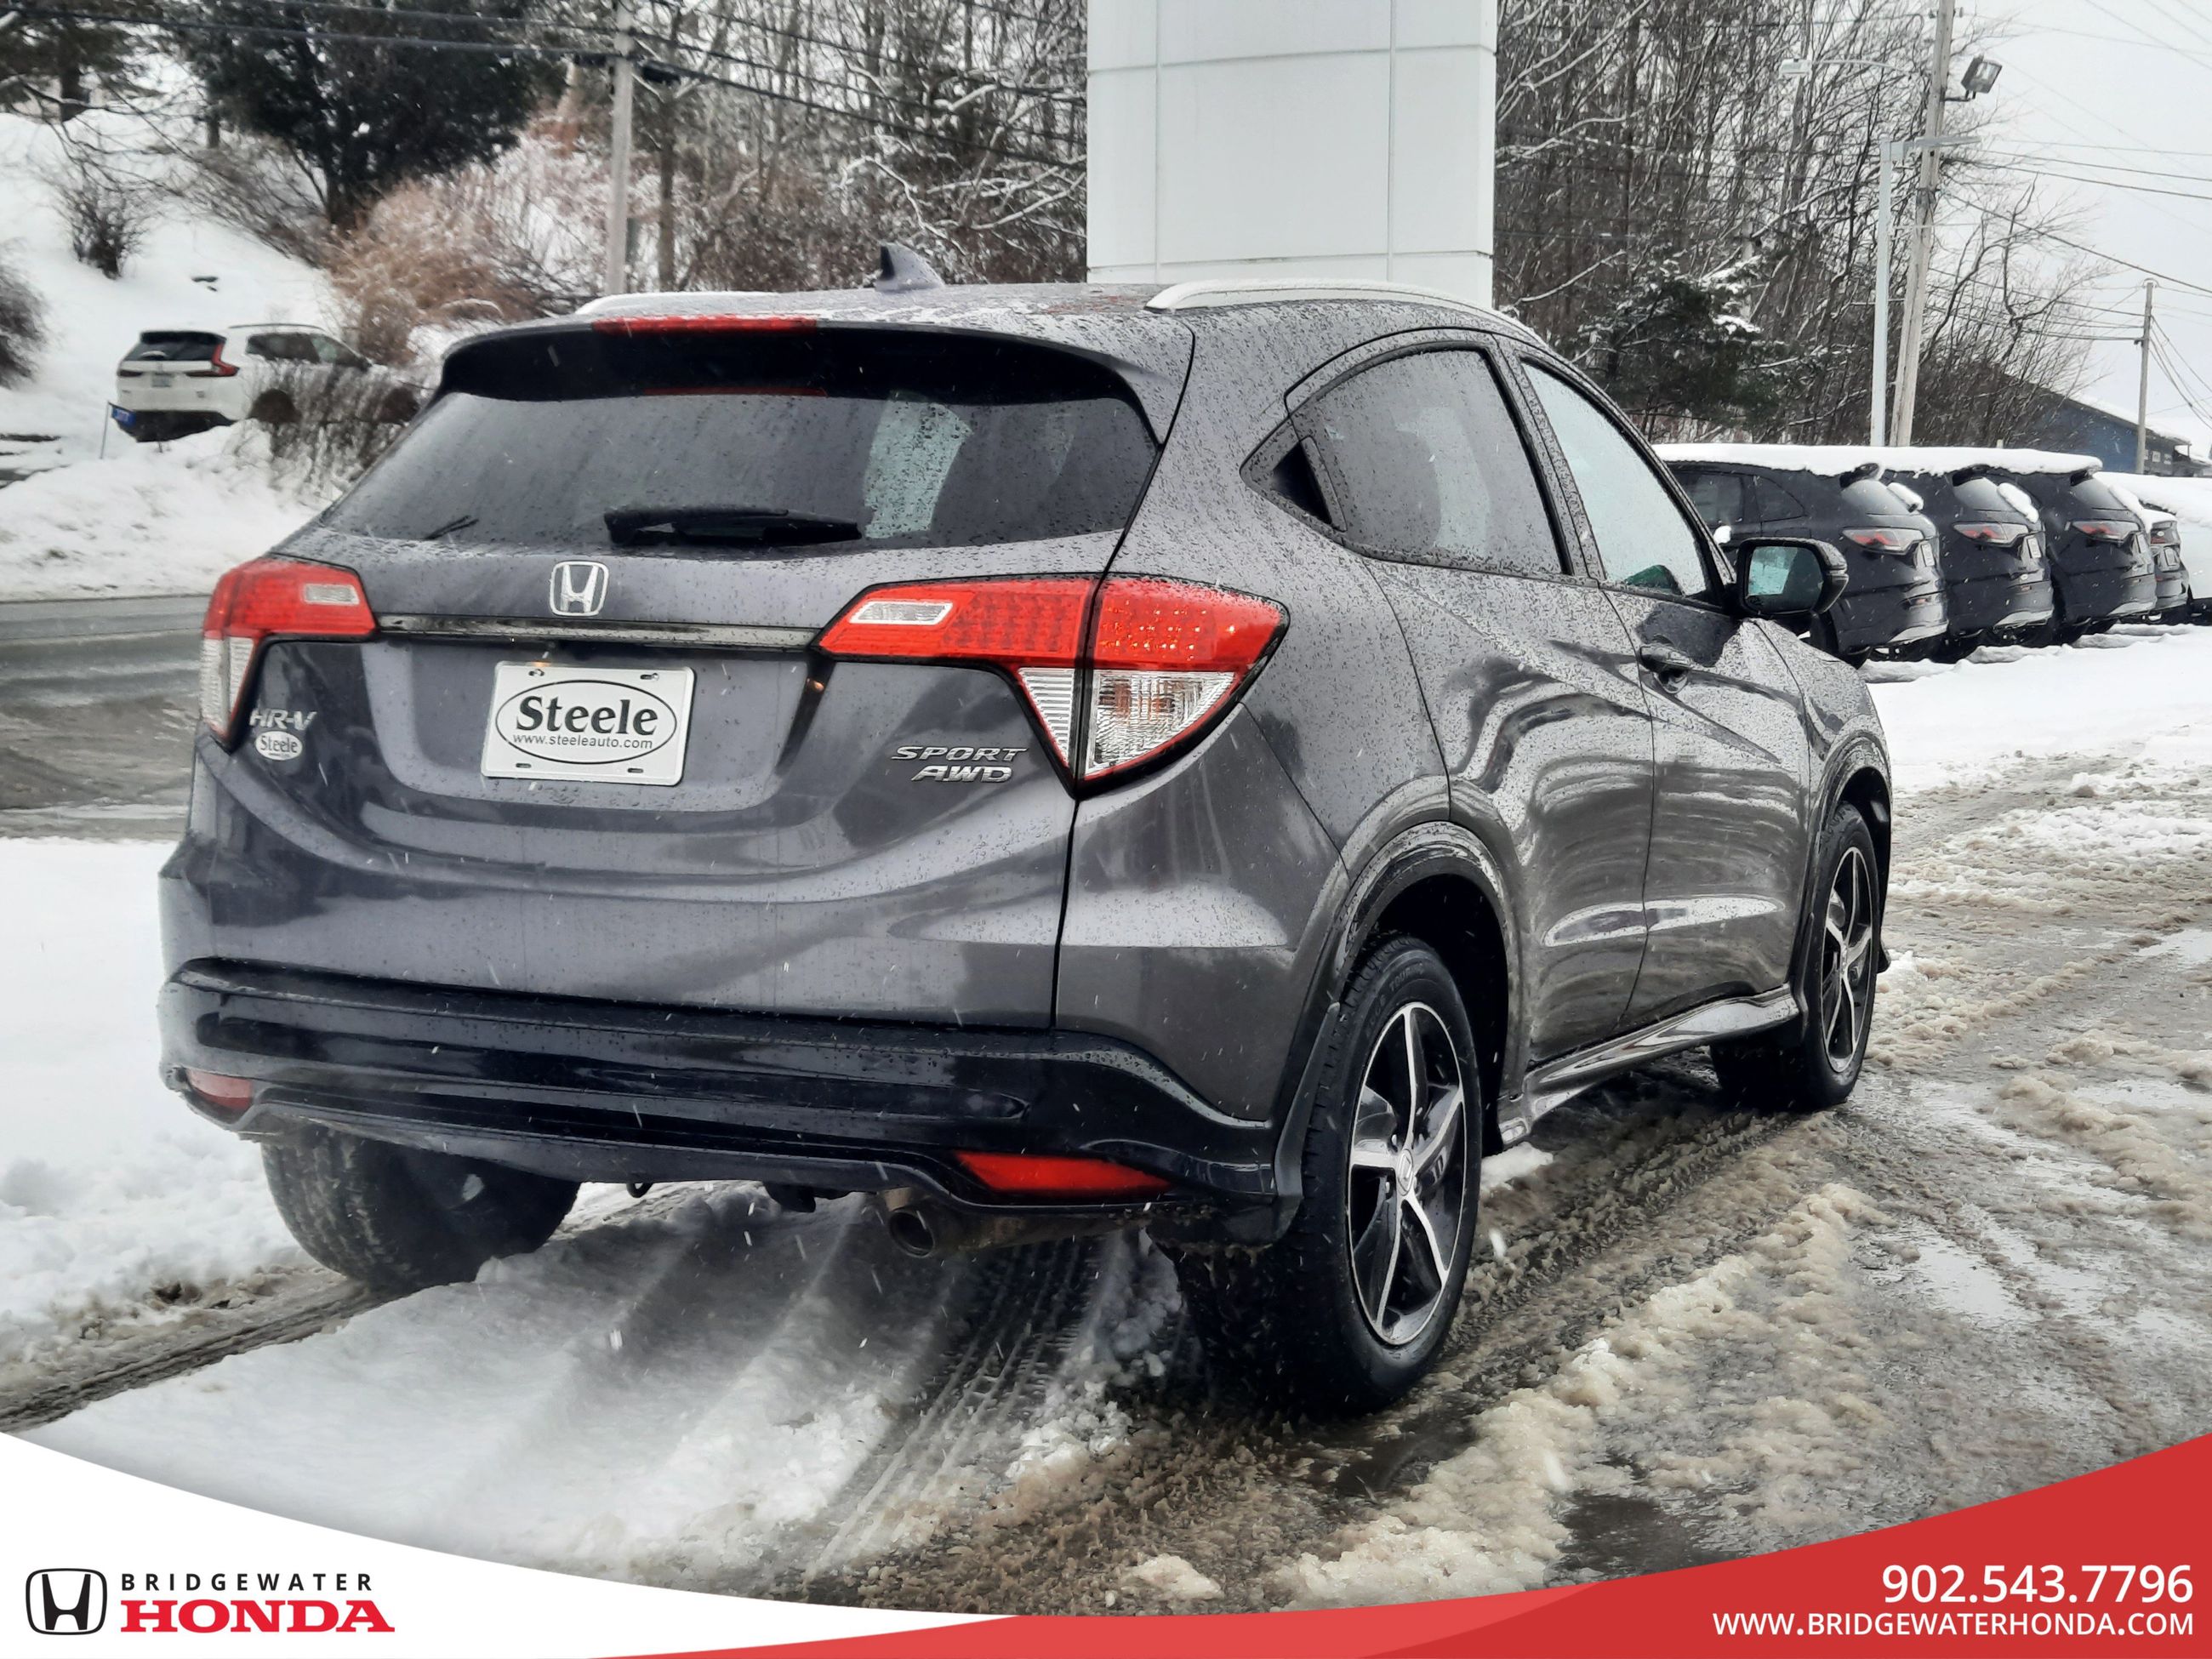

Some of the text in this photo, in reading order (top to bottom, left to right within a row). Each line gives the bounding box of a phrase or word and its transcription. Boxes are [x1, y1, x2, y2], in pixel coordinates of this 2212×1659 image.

[249, 708, 317, 731] HR-V
[516, 695, 658, 736] Steele
[259, 734, 298, 753] Steele
[513, 733, 653, 749] www.steeleauto.com
[892, 746, 1028, 762] SPORT
[911, 765, 1012, 784] AWD
